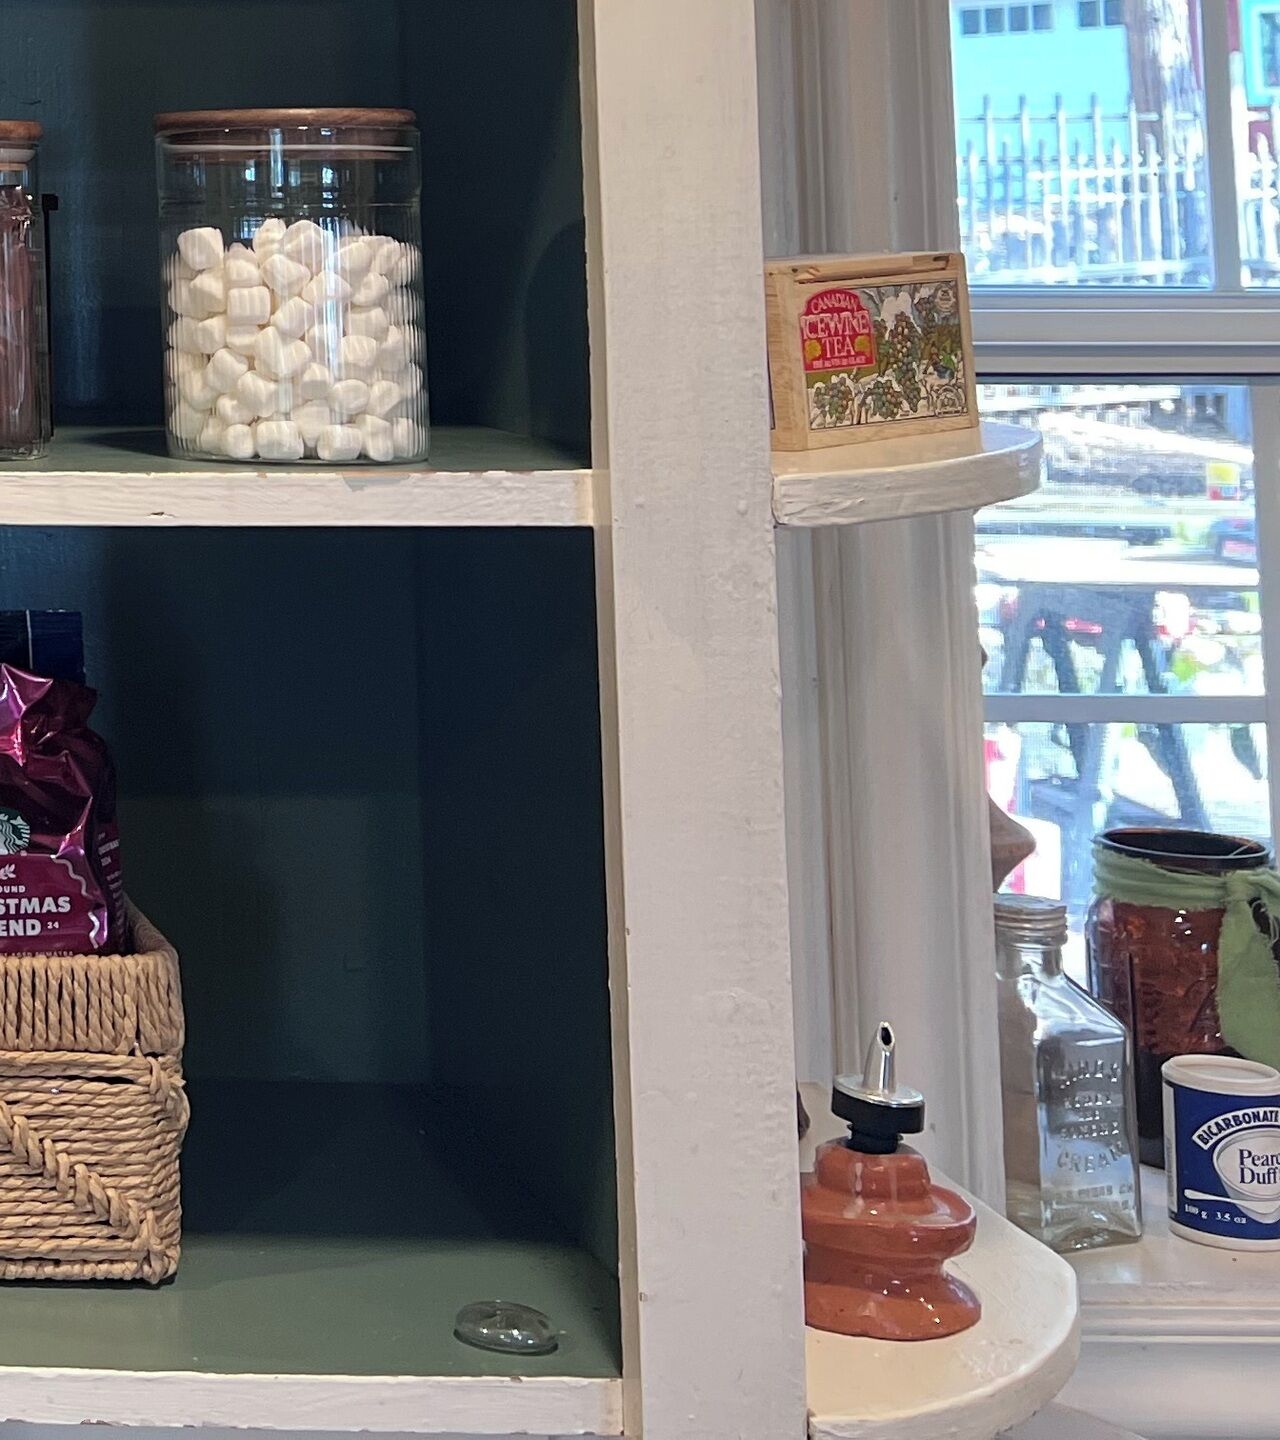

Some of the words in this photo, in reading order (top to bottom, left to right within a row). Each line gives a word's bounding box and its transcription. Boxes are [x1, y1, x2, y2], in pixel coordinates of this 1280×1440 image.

[811, 294, 858, 313] CANADIAN
[801, 310, 870, 339] ICEWINE
[822, 336, 855, 358] TEA
[1196, 1109, 1279, 1146] BICARBONATE
